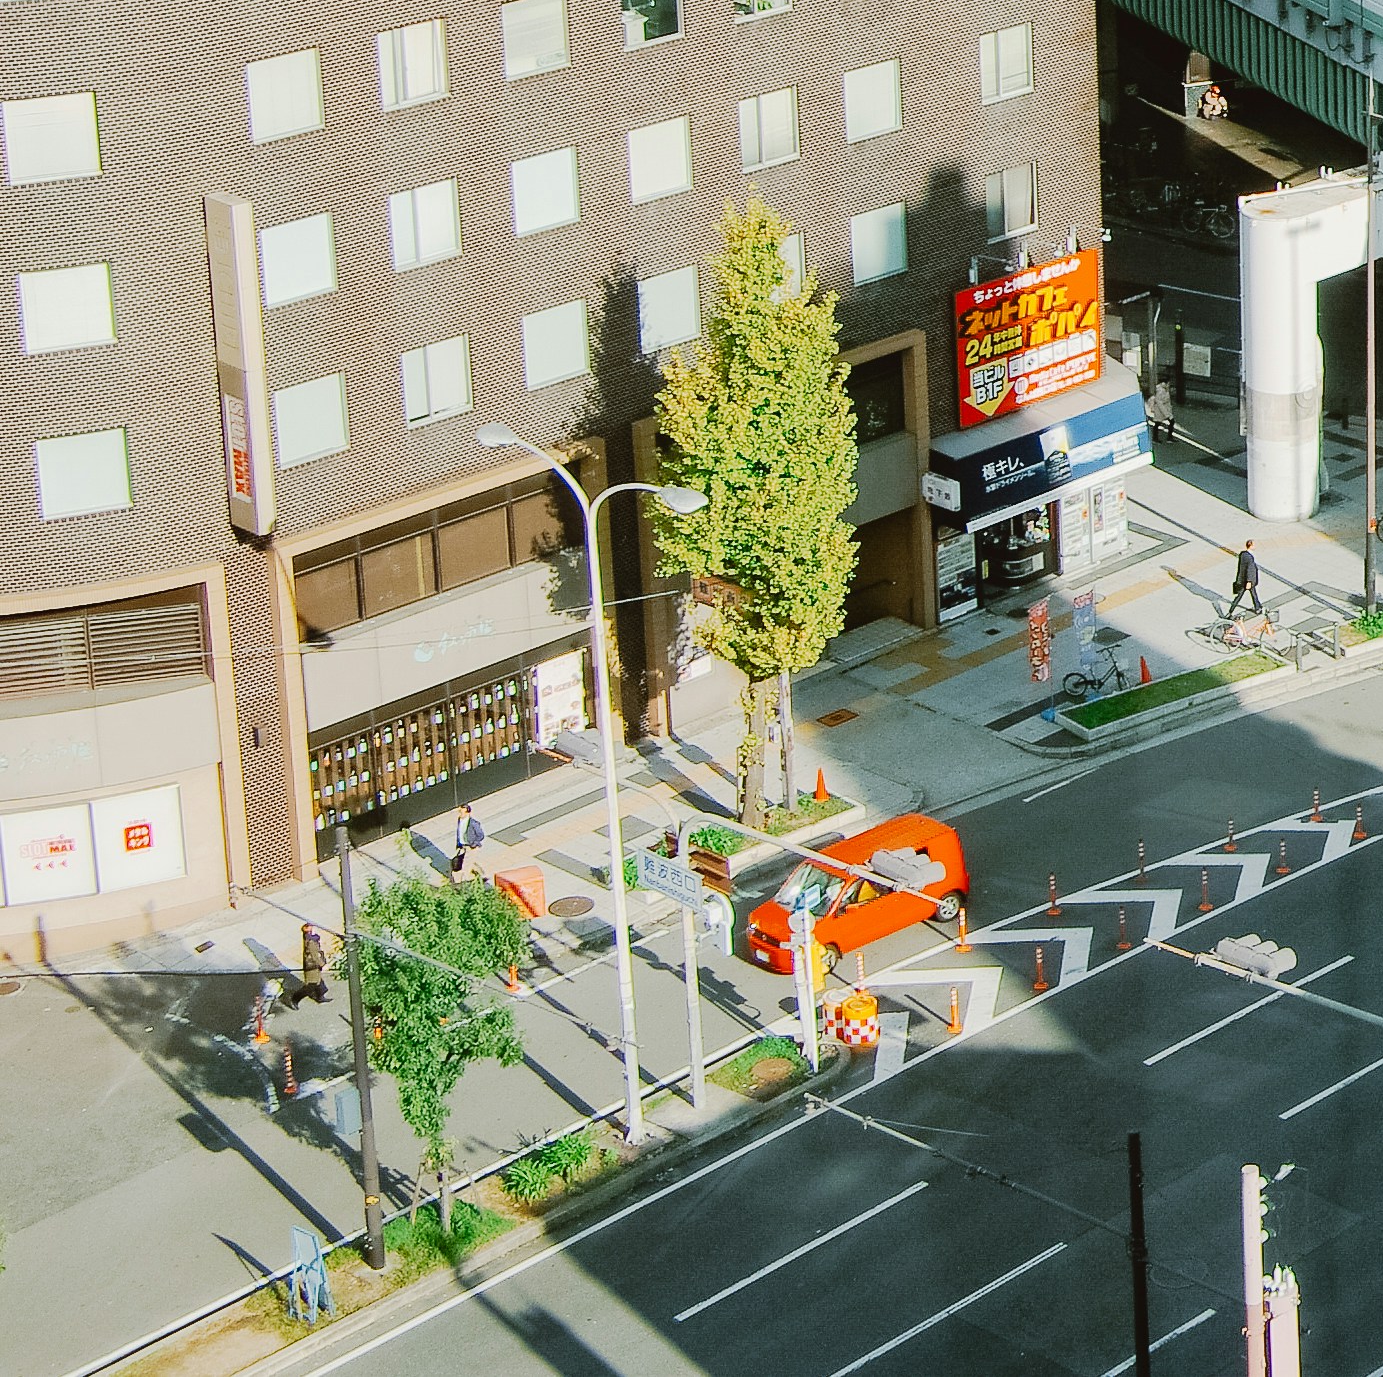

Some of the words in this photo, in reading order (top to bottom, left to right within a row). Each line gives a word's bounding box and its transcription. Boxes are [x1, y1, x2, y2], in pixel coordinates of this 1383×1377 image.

[965, 285, 1069, 335] ネットカフェ
[1030, 301, 1098, 346] ポパイ
[965, 334, 993, 366] 24
[973, 364, 1006, 388] 当ビル
[976, 381, 1004, 405] B1F
[644, 856, 696, 893] 難波西口
